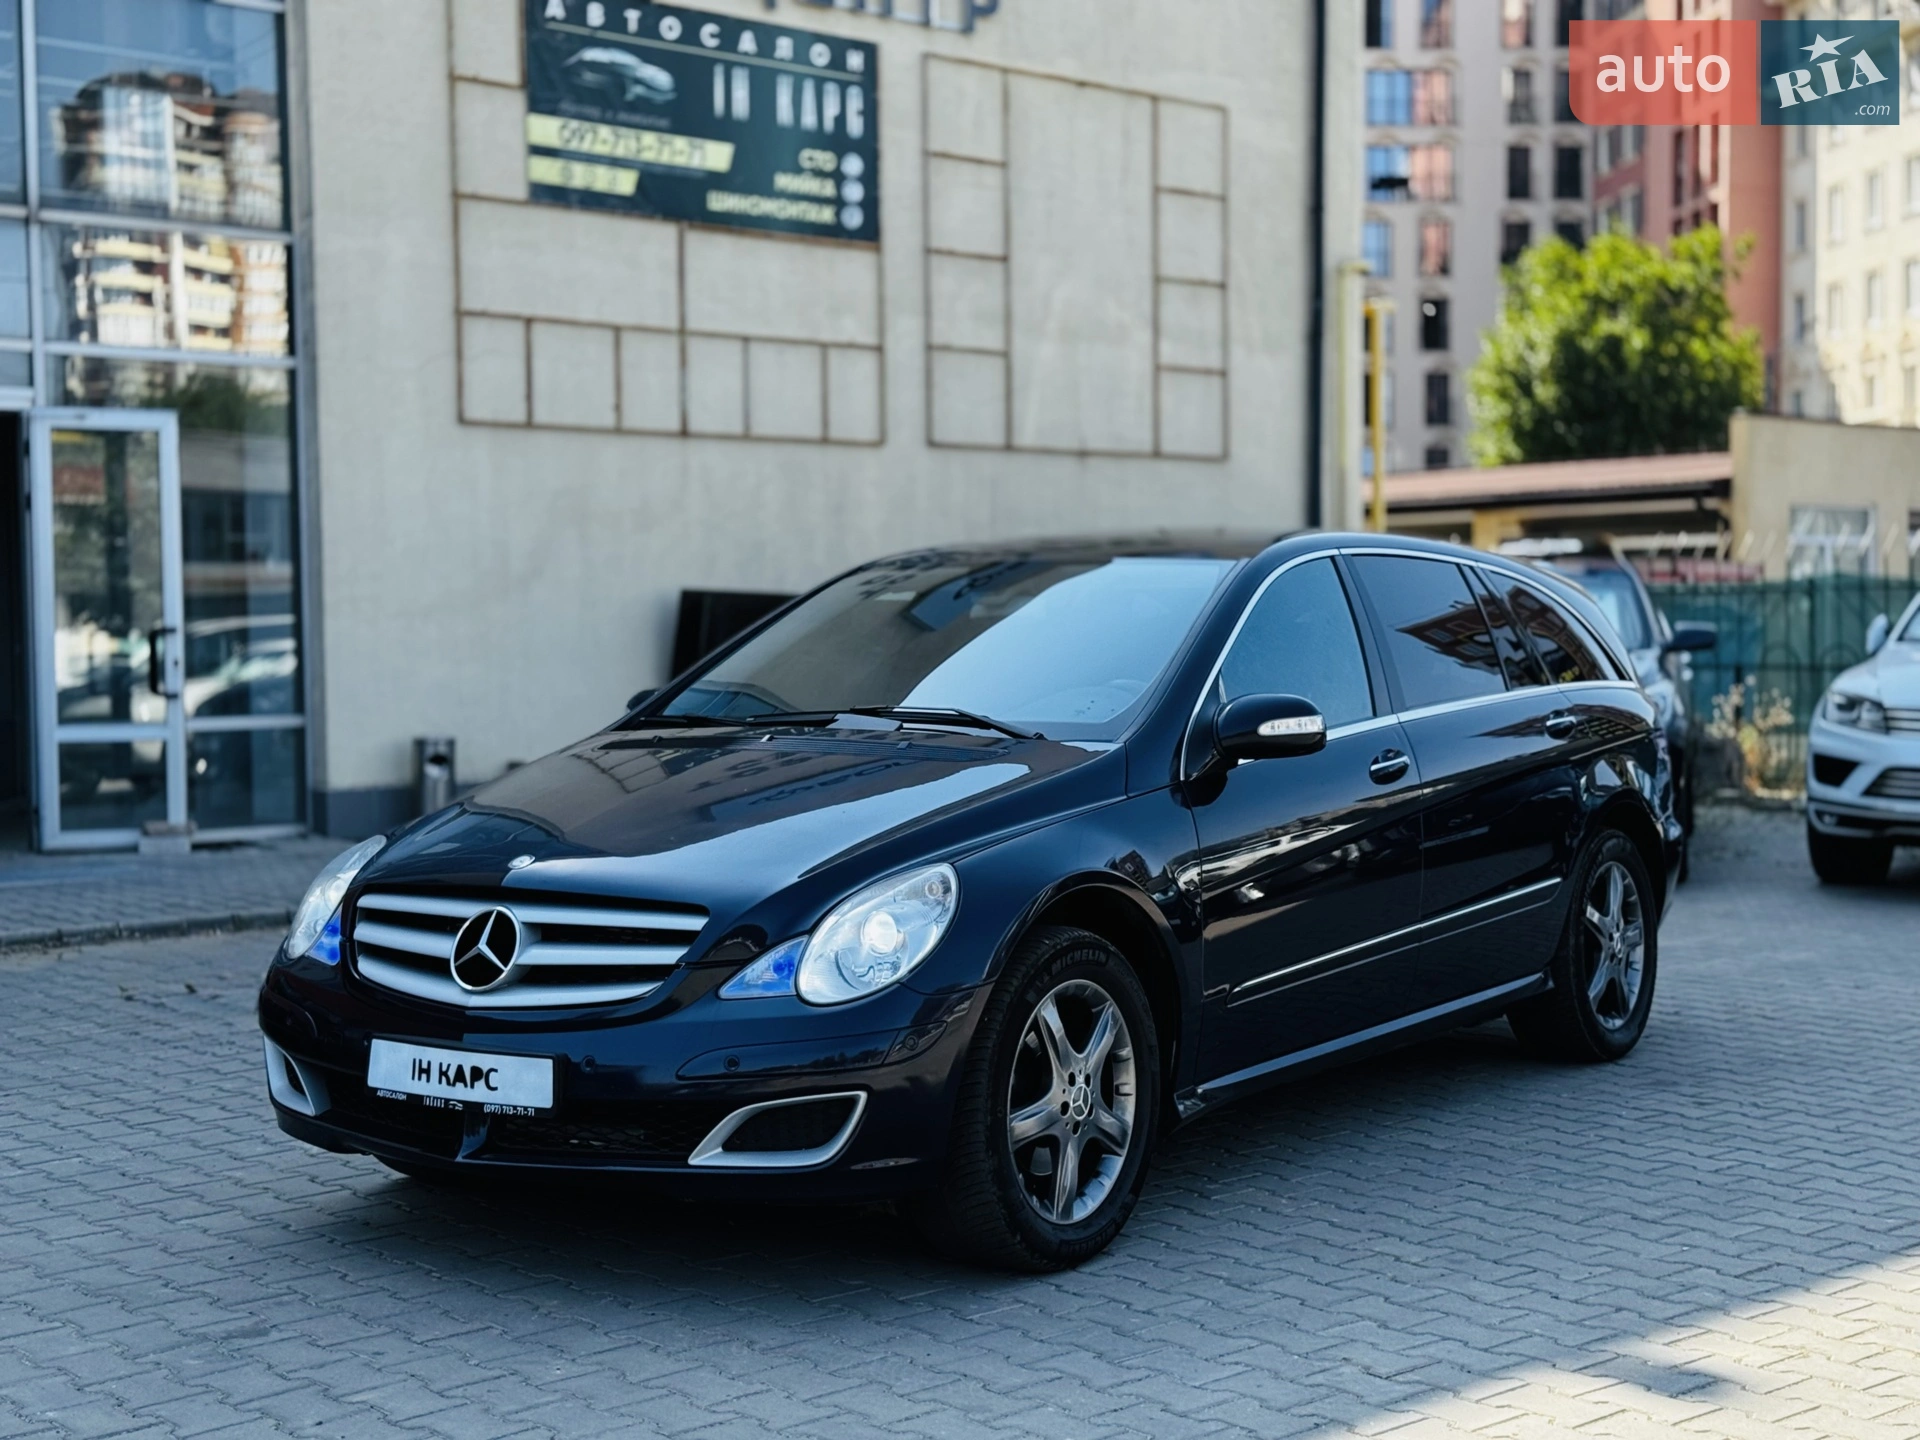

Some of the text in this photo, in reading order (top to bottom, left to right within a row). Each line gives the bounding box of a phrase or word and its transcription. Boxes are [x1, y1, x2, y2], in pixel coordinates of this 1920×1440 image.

[544, 0, 865, 73] АВТОСАЛОН
[798, 147, 838, 172] СТО
[1051, 948, 1109, 976] MICHELIN
[438, 1061, 499, 1092] КАРС
[376, 1089, 407, 1101] АВТОСАЛОН
[483, 1104, 535, 1117] (097) 713-71-71
